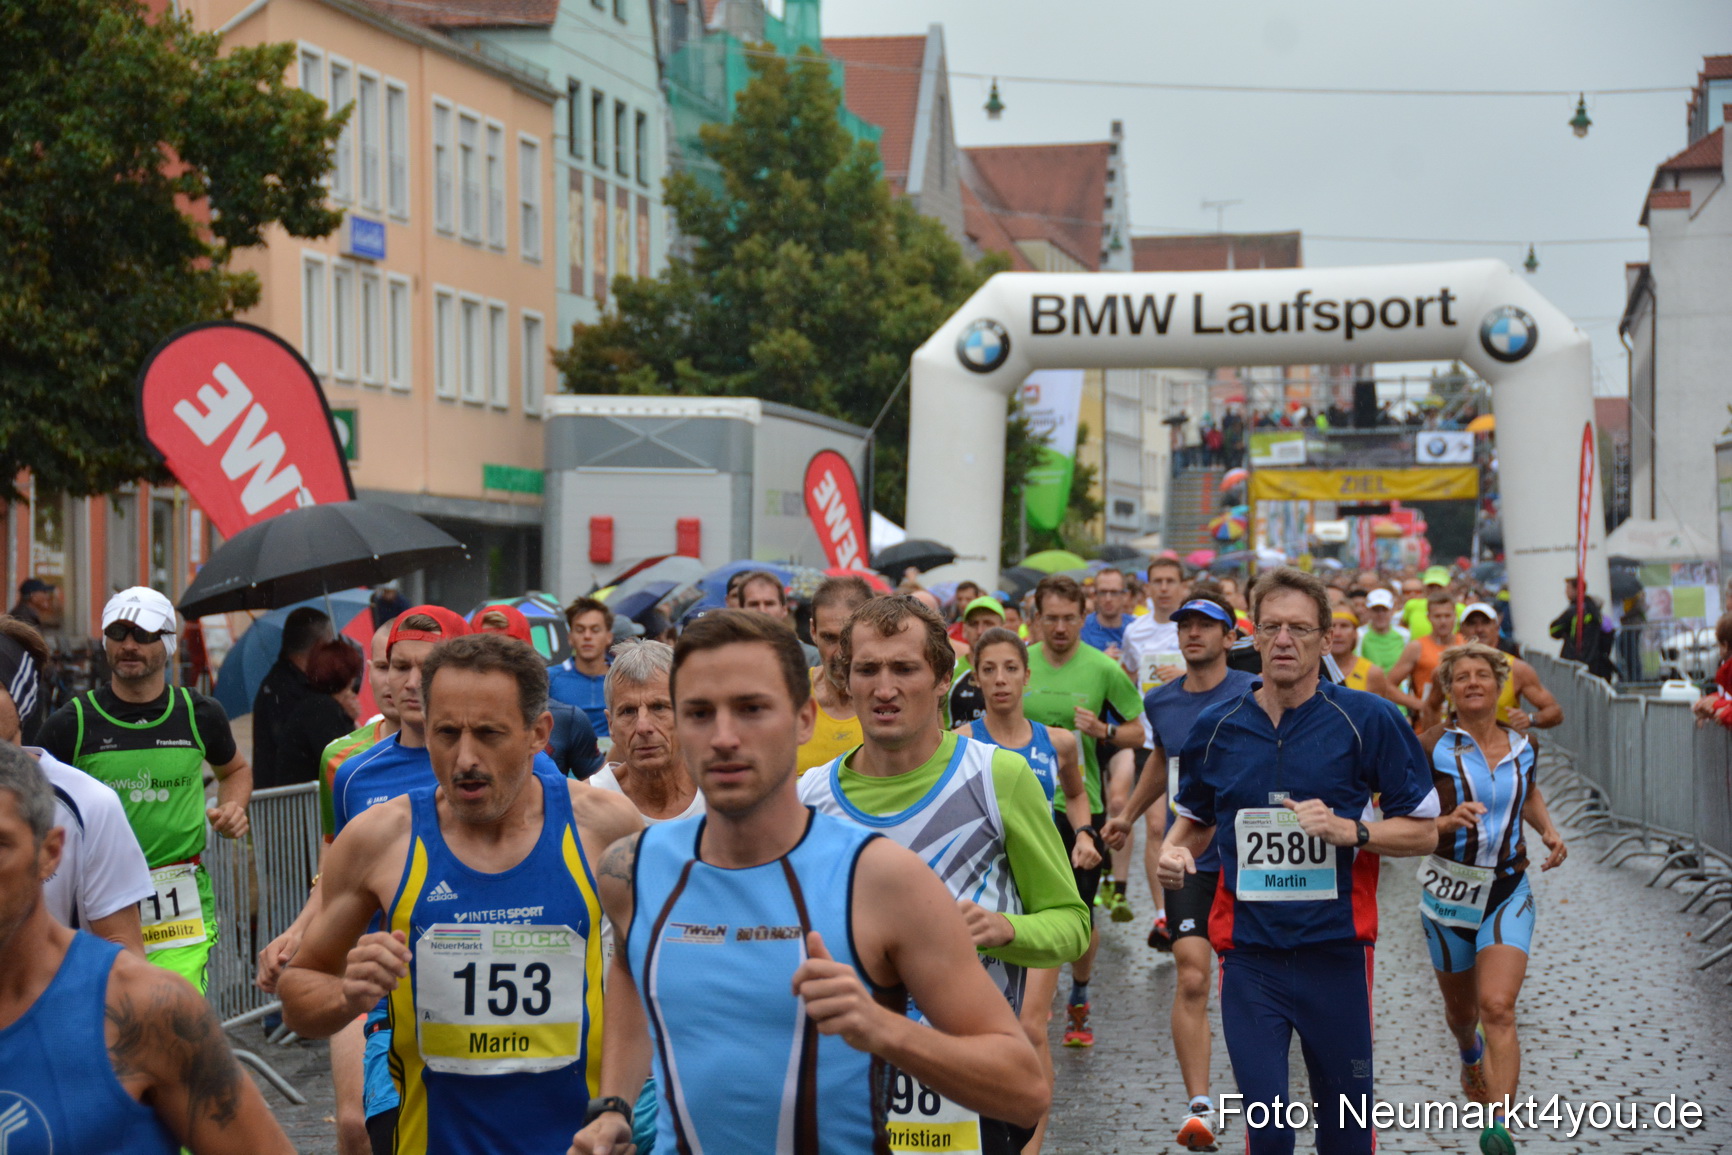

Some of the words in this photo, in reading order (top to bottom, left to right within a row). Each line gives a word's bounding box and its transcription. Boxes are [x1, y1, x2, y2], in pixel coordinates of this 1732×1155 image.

[1031, 293, 1176, 336] BMW
[1192, 288, 1457, 340] Laufsport
[172, 361, 316, 515] WE
[1340, 474, 1388, 494] ZIEL
[156, 738, 192, 746] FrankenBlitz
[151, 778, 174, 788] Run
[174, 778, 181, 788] &
[181, 776, 192, 787] Fit
[1246, 831, 1327, 866] 2580
[1264, 873, 1307, 888] Martin
[1422, 868, 1482, 905] 2801
[426, 892, 459, 902] adidas
[468, 905, 545, 922] INTERSPORT
[1434, 902, 1457, 918] Petra
[143, 924, 195, 942] nkenBlitz
[493, 930, 571, 948] BOCK
[430, 941, 483, 950] NeuerMarkt
[453, 962, 552, 1017] 153
[424, 1010, 431, 1020] A
[469, 1032, 530, 1053] Mario
[887, 1128, 951, 1148] hristian
